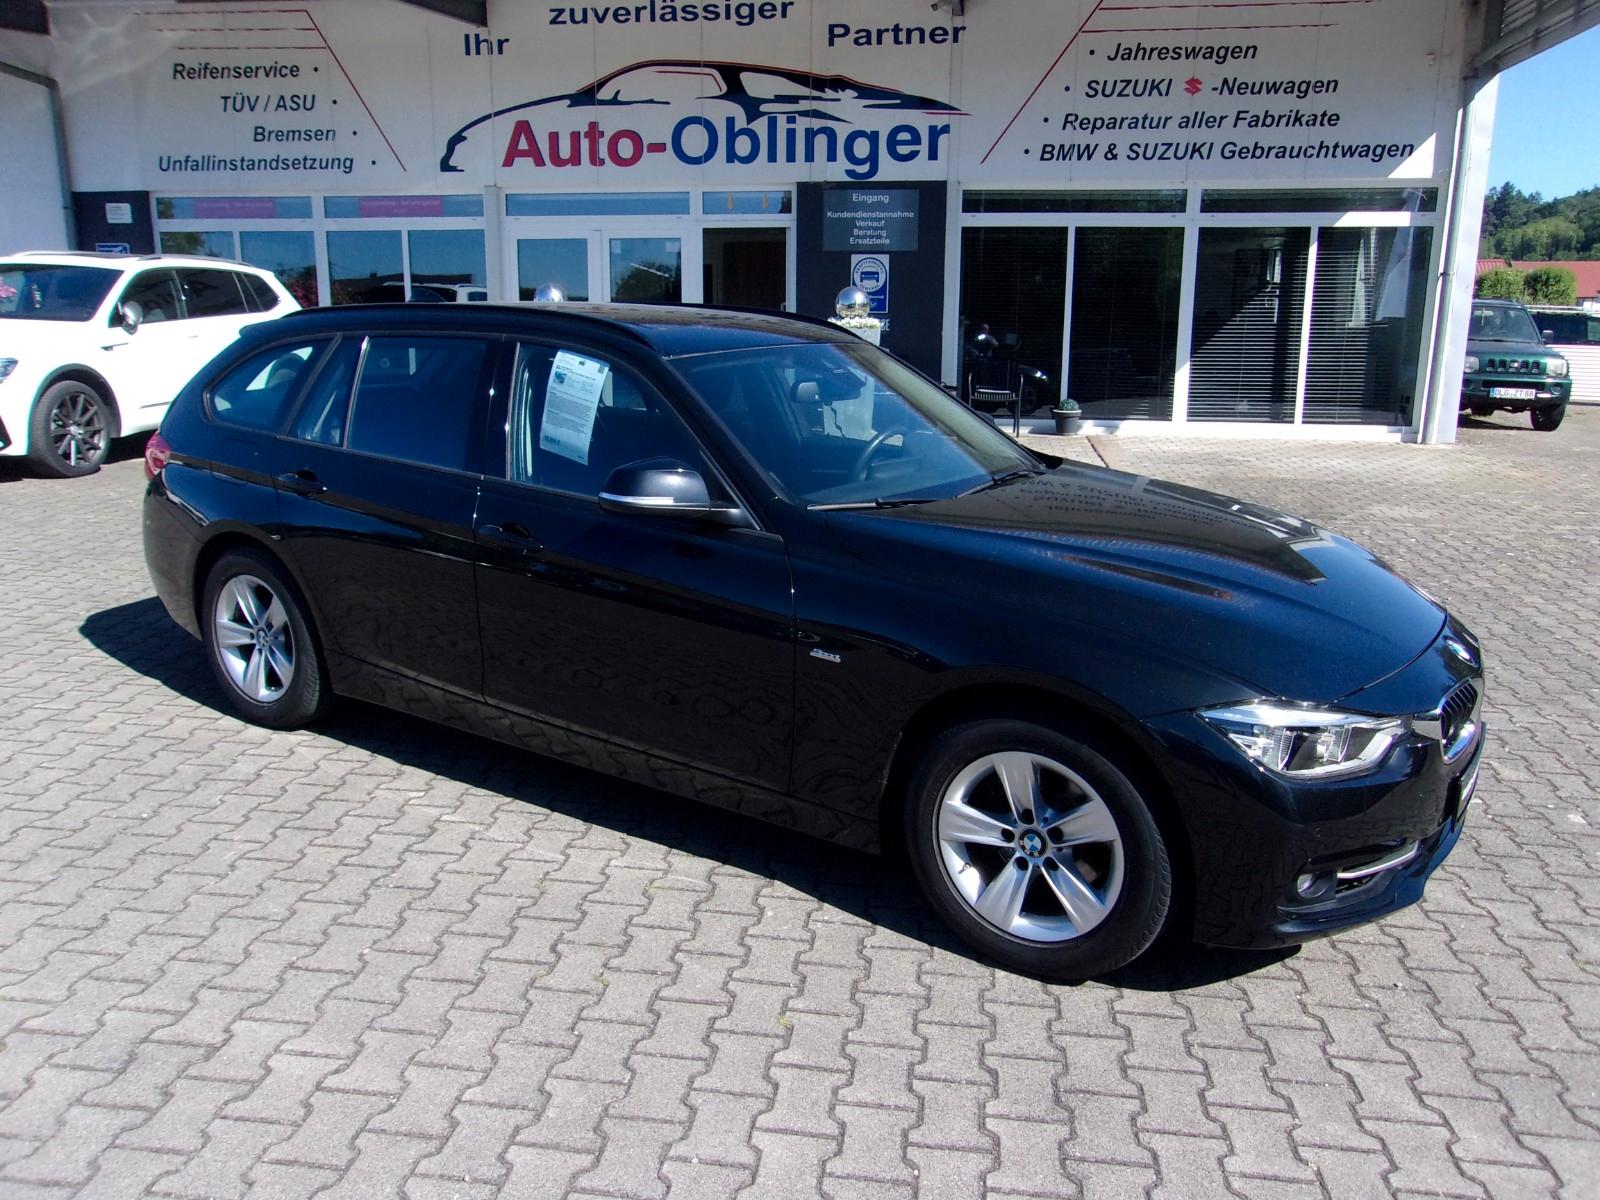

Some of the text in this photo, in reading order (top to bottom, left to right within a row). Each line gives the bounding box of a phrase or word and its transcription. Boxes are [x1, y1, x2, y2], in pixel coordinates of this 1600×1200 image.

[548, 0, 795, 27] zuverlässiger
[463, 33, 511, 56] Ihr
[828, 23, 967, 48] Partner
[1106, 42, 1258, 65] Jahreswagen
[172, 61, 300, 80] Reifenservice
[1084, 78, 1173, 98] SUZUKI
[220, 92, 260, 112] TÜV
[274, 94, 316, 112] ASU
[1062, 109, 1340, 135] Reparatur aller Fabrikate
[252, 126, 337, 142] Bremsen
[501, 115, 951, 181] Auto-Oblinger
[1039, 140, 1415, 163] BMW & SUZUKI Gebrauchtwagen
[158, 154, 354, 174] Unfallinstandsetzung
[852, 193, 890, 204] Eingang
[826, 210, 915, 219] Kundendienstannahme
[855, 219, 886, 228] Verkauf
[849, 237, 890, 245] Ersatzteile
[853, 228, 887, 237] Beratung
